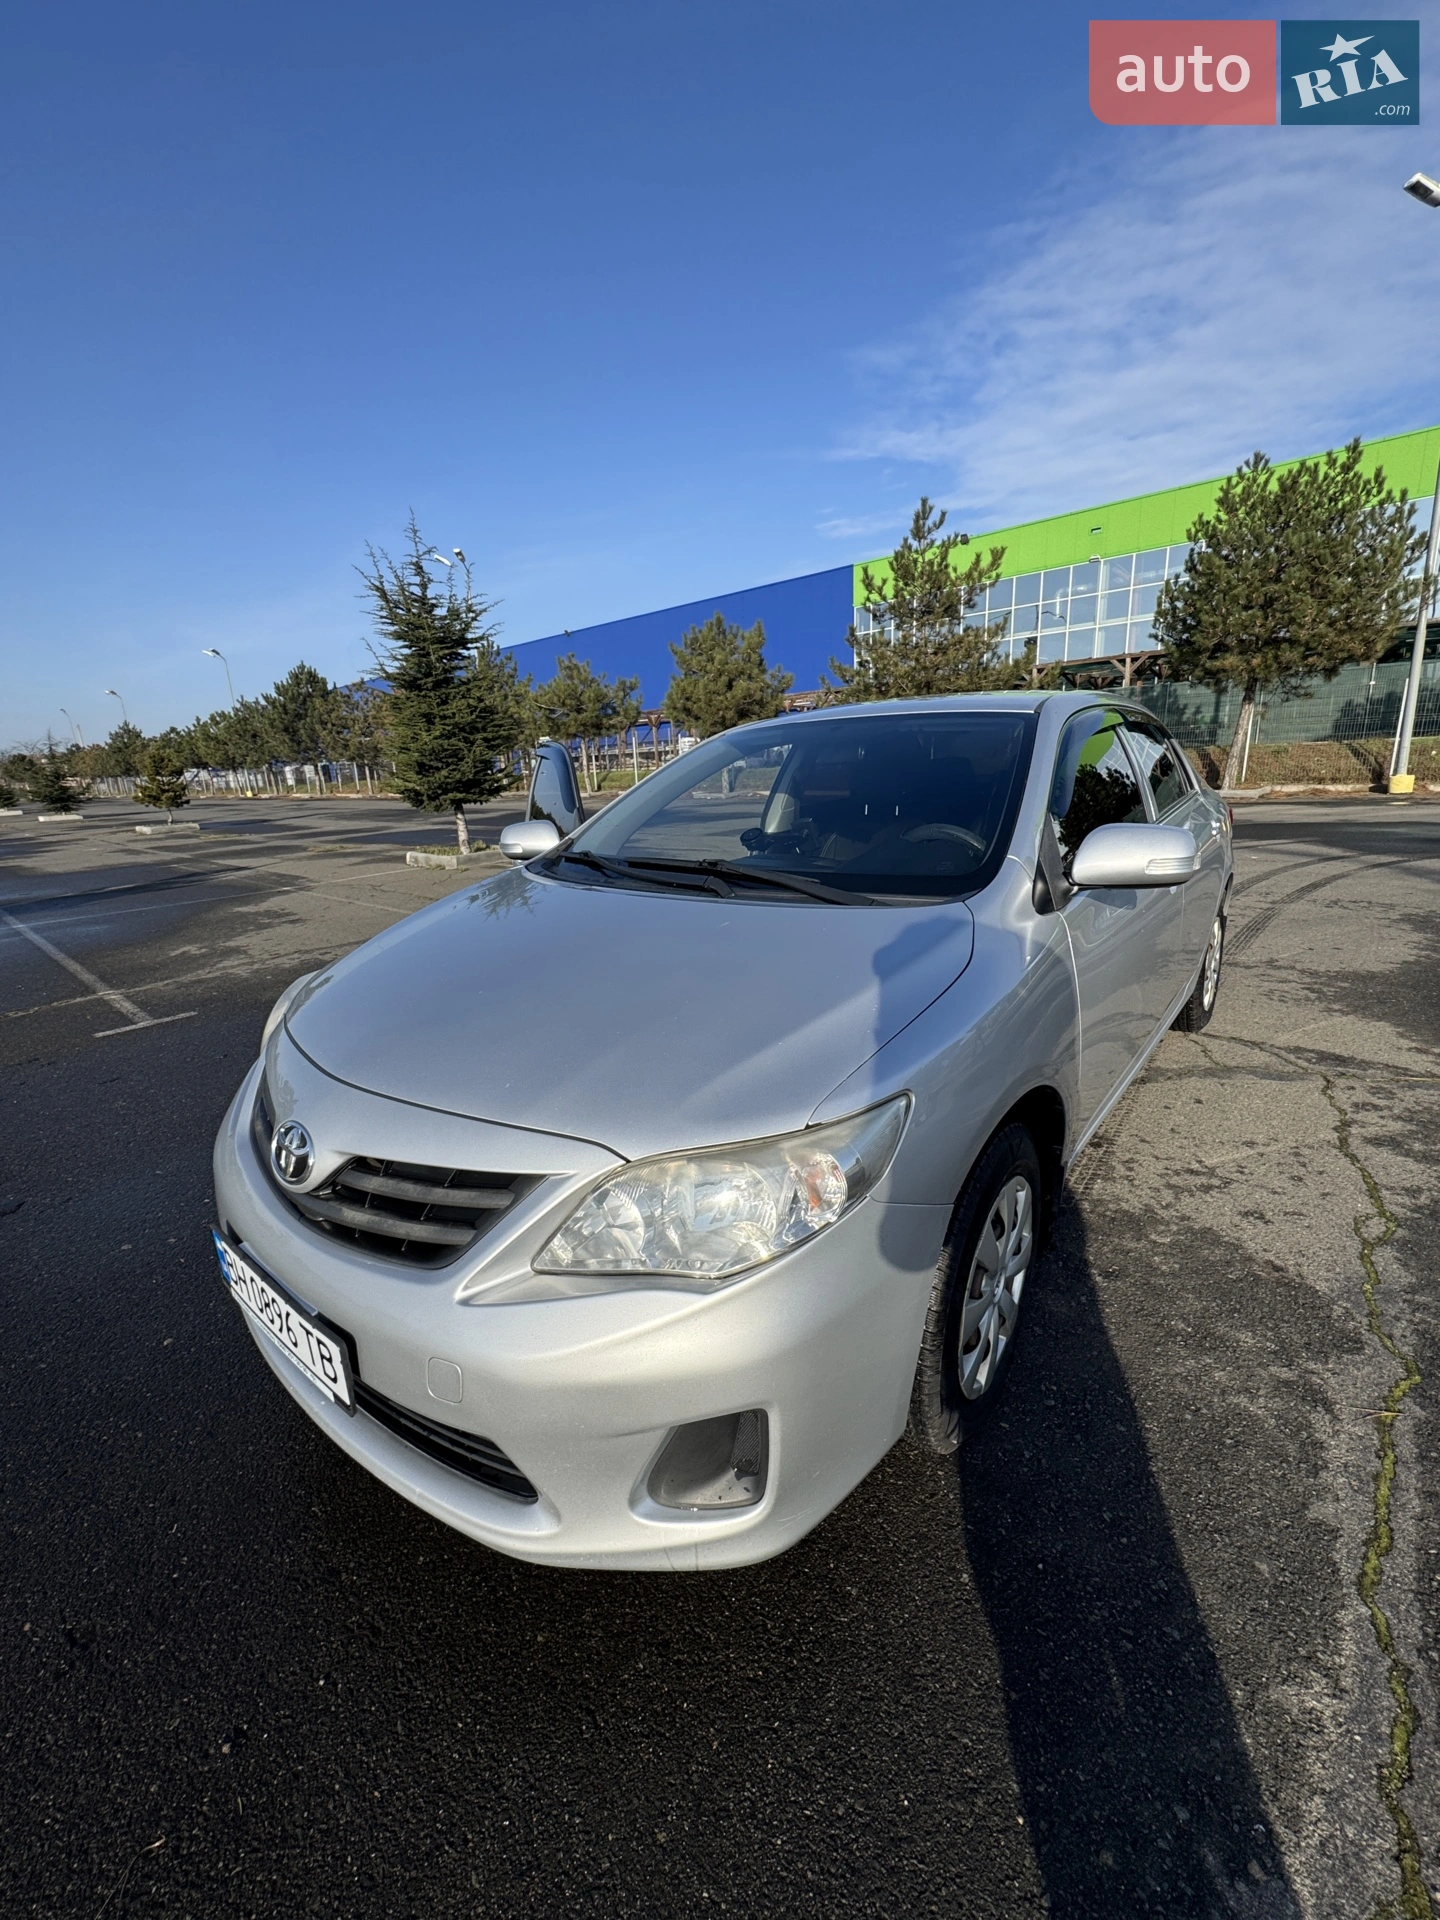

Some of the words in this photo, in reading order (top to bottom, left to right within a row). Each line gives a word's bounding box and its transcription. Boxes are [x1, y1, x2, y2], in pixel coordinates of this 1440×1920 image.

[223, 1247, 252, 1303] BH
[250, 1276, 298, 1349] 0896
[298, 1321, 338, 1385] TB
